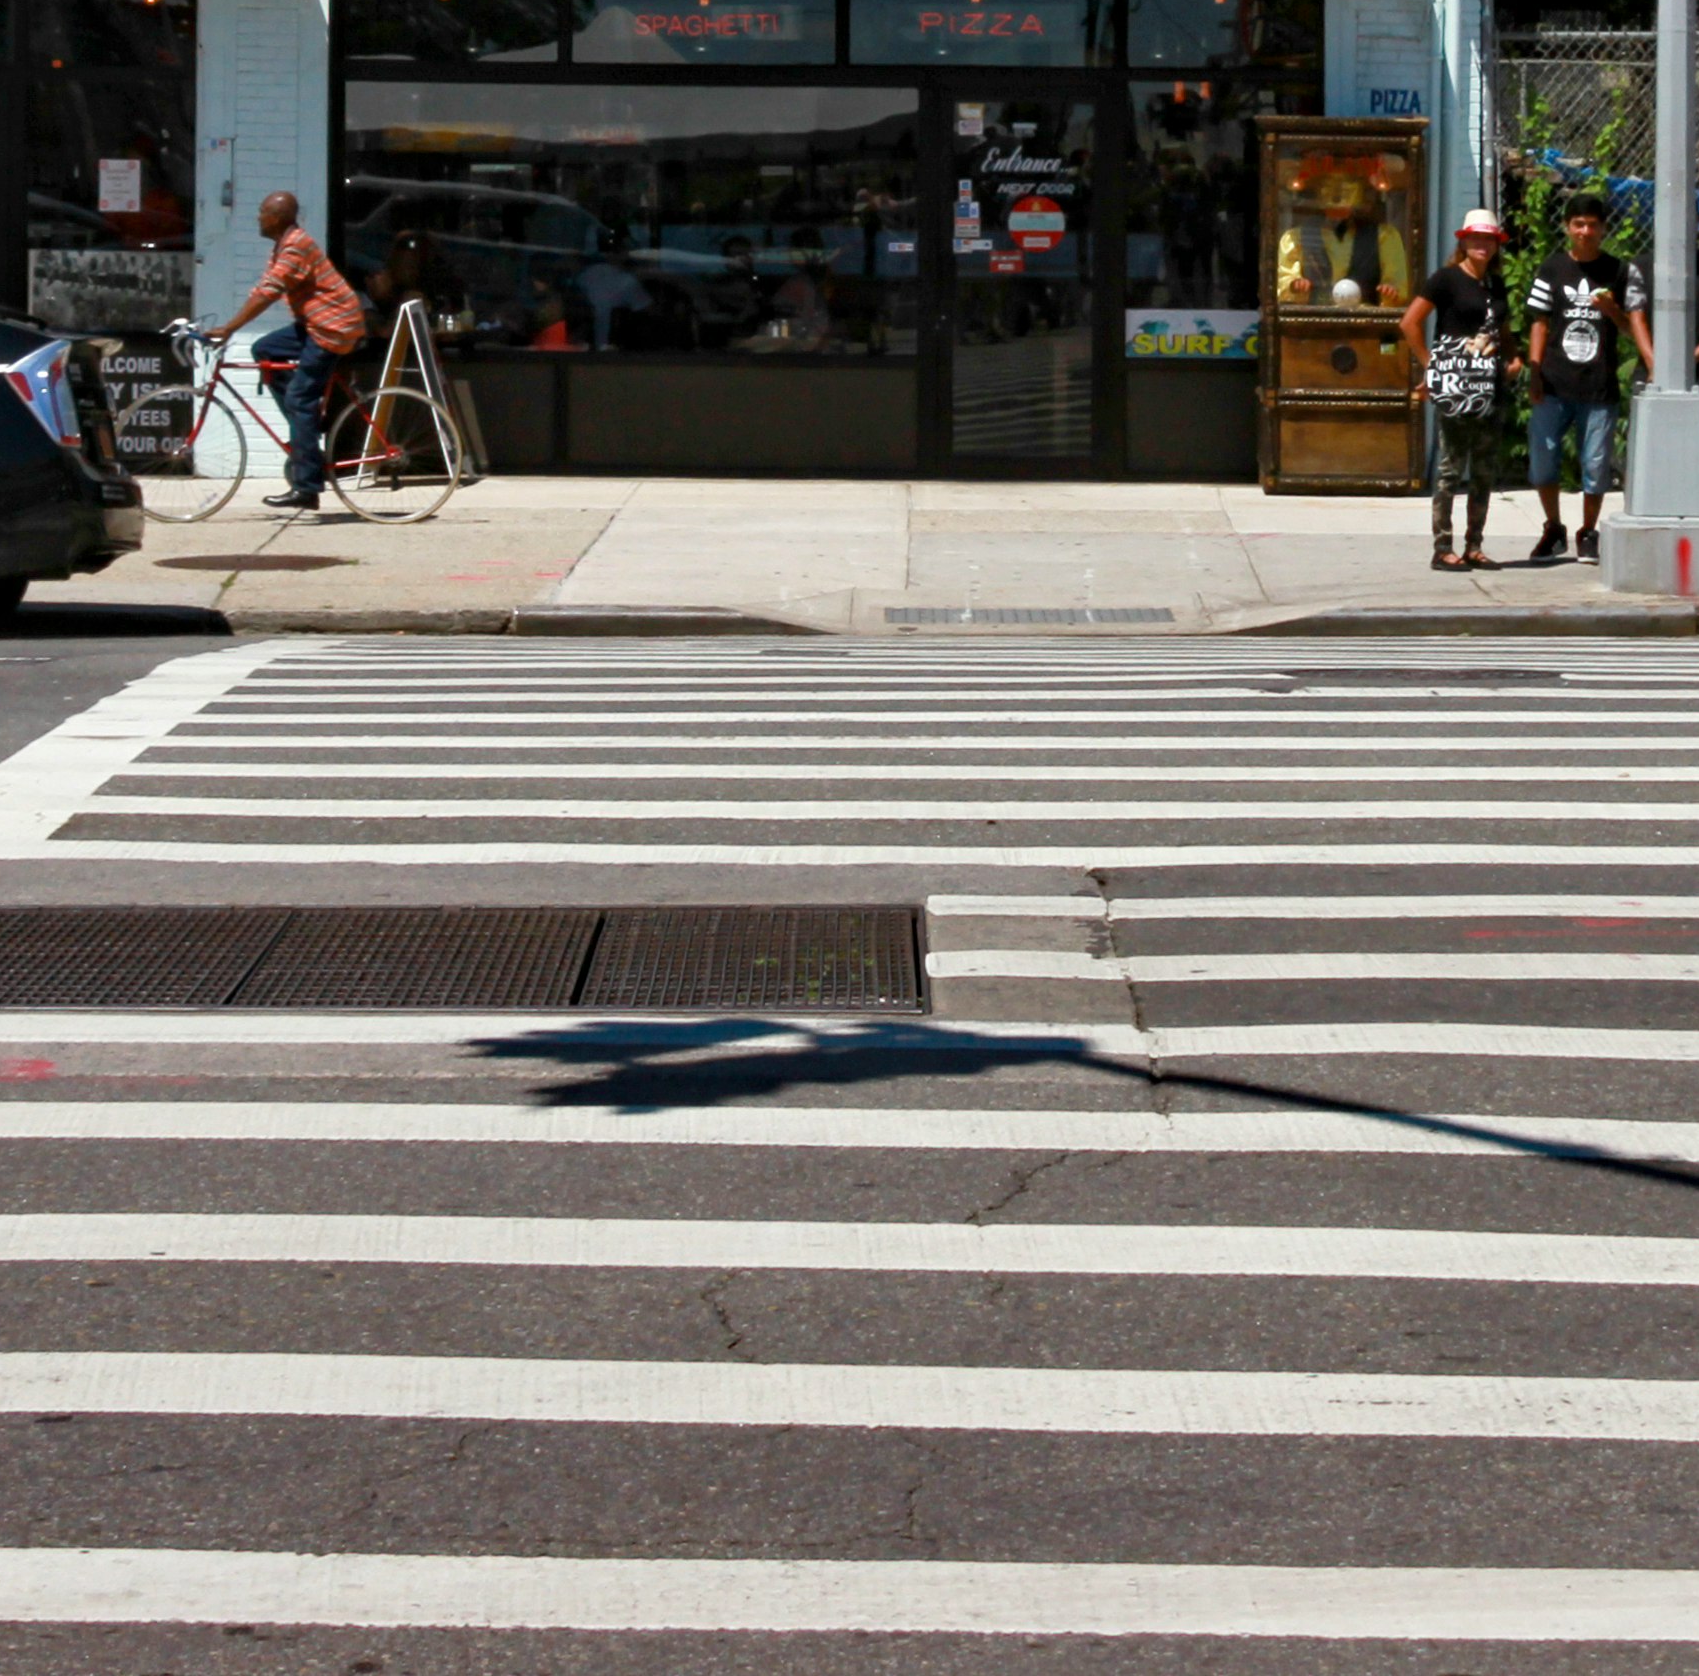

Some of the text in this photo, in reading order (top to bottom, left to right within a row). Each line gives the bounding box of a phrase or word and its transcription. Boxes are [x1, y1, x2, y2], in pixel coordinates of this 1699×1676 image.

[633, 12, 779, 37] SPAGHETTI
[918, 11, 1045, 36] PIZZA
[1369, 88, 1422, 114] PIZZA
[997, 182, 1076, 195] NEXT DOOR
[1563, 307, 1602, 320] adidas
[1132, 334, 1231, 355] SURF
